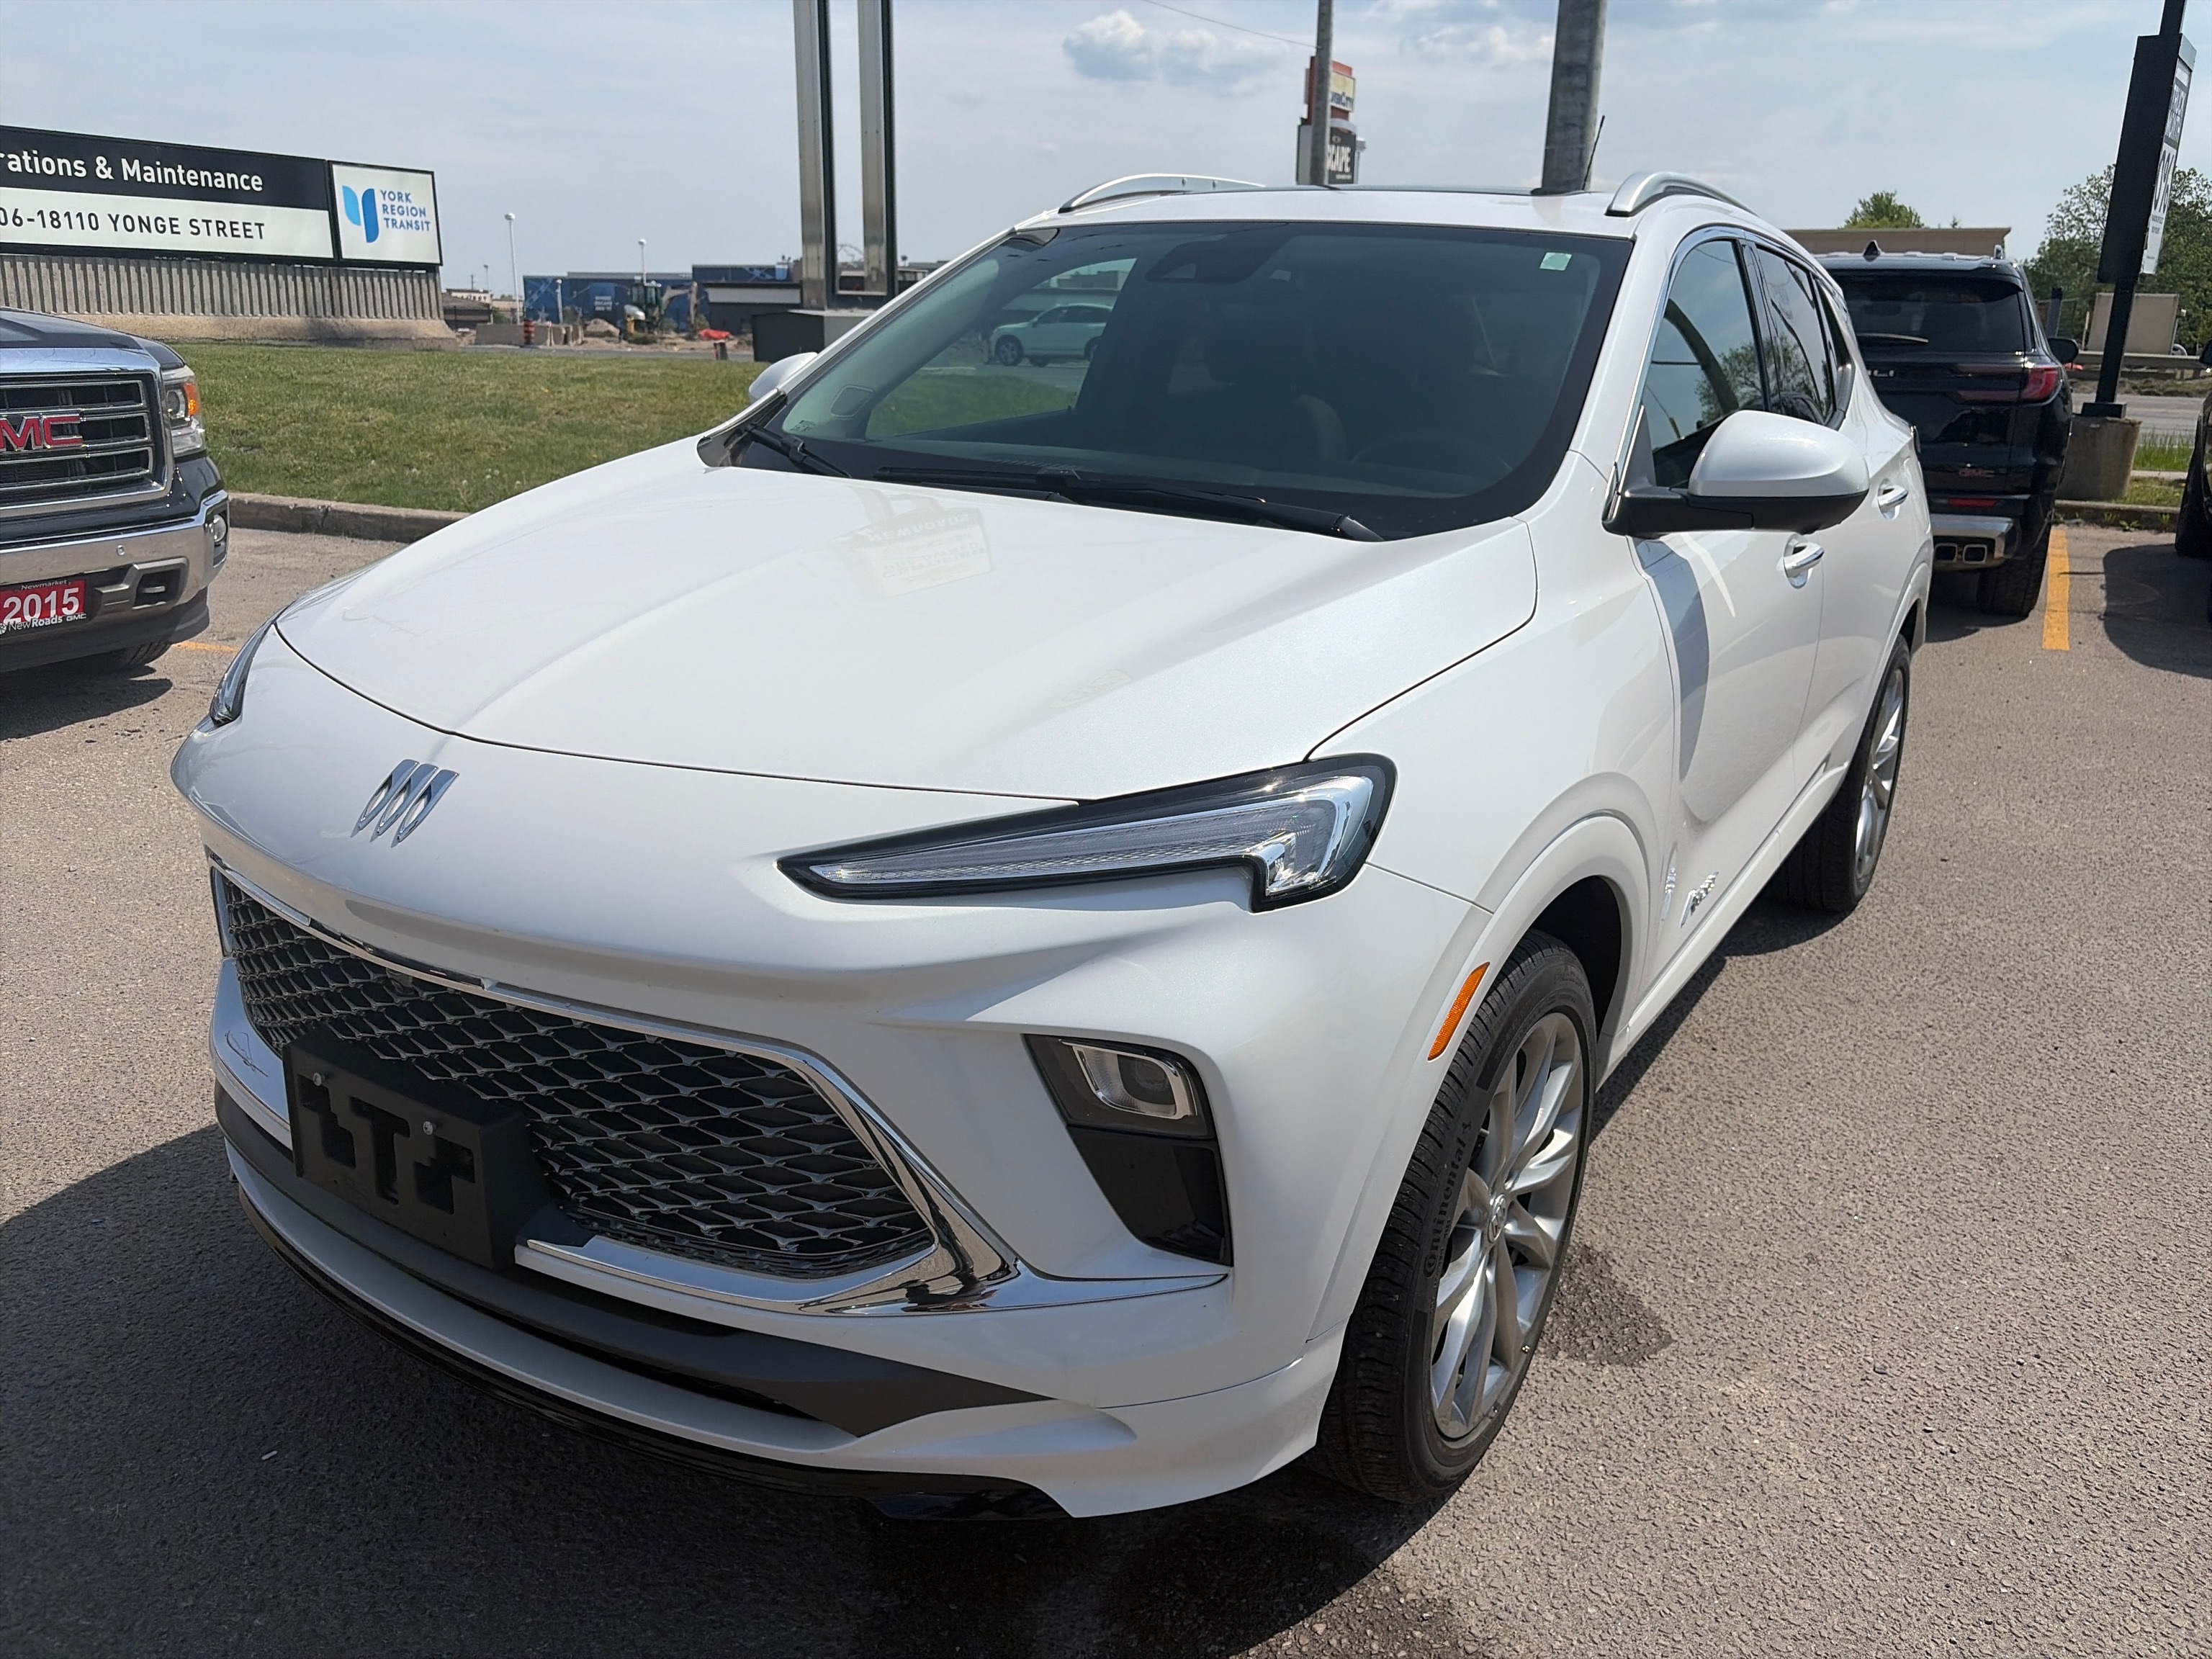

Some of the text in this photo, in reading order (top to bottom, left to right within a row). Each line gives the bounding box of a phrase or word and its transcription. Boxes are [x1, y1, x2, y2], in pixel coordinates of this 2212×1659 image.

[96, 156, 114, 179] &
[121, 158, 264, 192] Maintenance
[380, 189, 413, 203] YORK
[382, 204, 427, 217] REGION
[107, 213, 181, 235] YONGE
[189, 218, 265, 240] STREET
[384, 217, 431, 231] TRANSIT
[21, 580, 68, 590] Newmarket
[3, 587, 79, 625] 2015
[9, 613, 86, 631] NewRoads GMC
